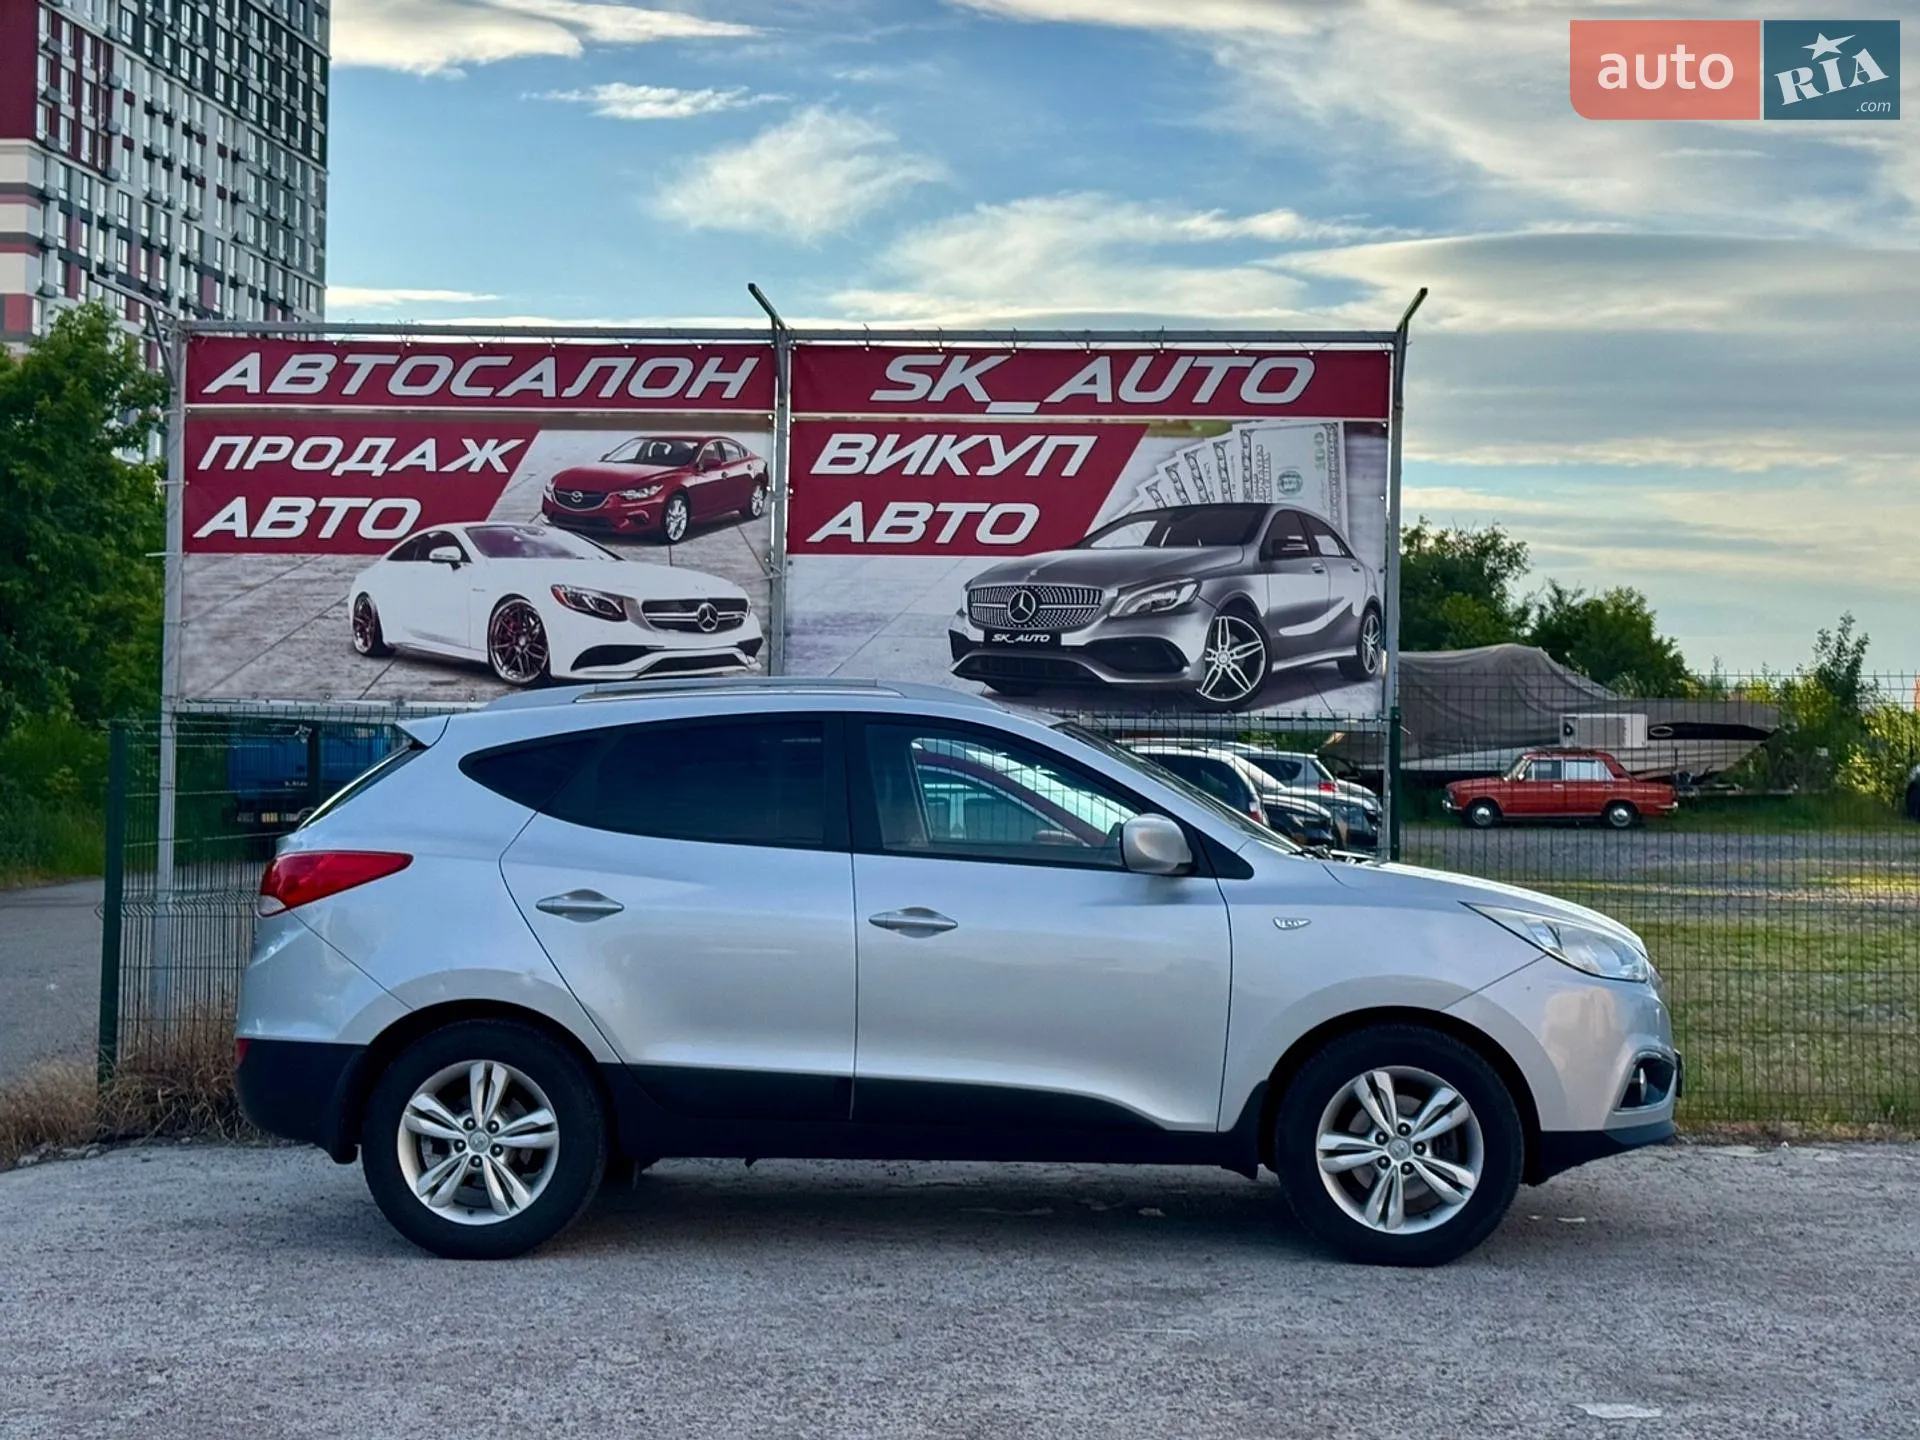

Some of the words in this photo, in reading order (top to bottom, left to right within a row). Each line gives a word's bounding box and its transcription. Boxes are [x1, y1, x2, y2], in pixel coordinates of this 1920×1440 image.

[202, 352, 759, 400] АВТОСАЛОН
[870, 354, 1316, 414] SK_AUTO
[198, 435, 525, 478] ПРОДАЖ
[809, 433, 1098, 478] ВИКУП
[193, 496, 422, 541] АВТО
[806, 501, 1040, 545] АВТО
[992, 633, 1051, 644] SK_AUTO
